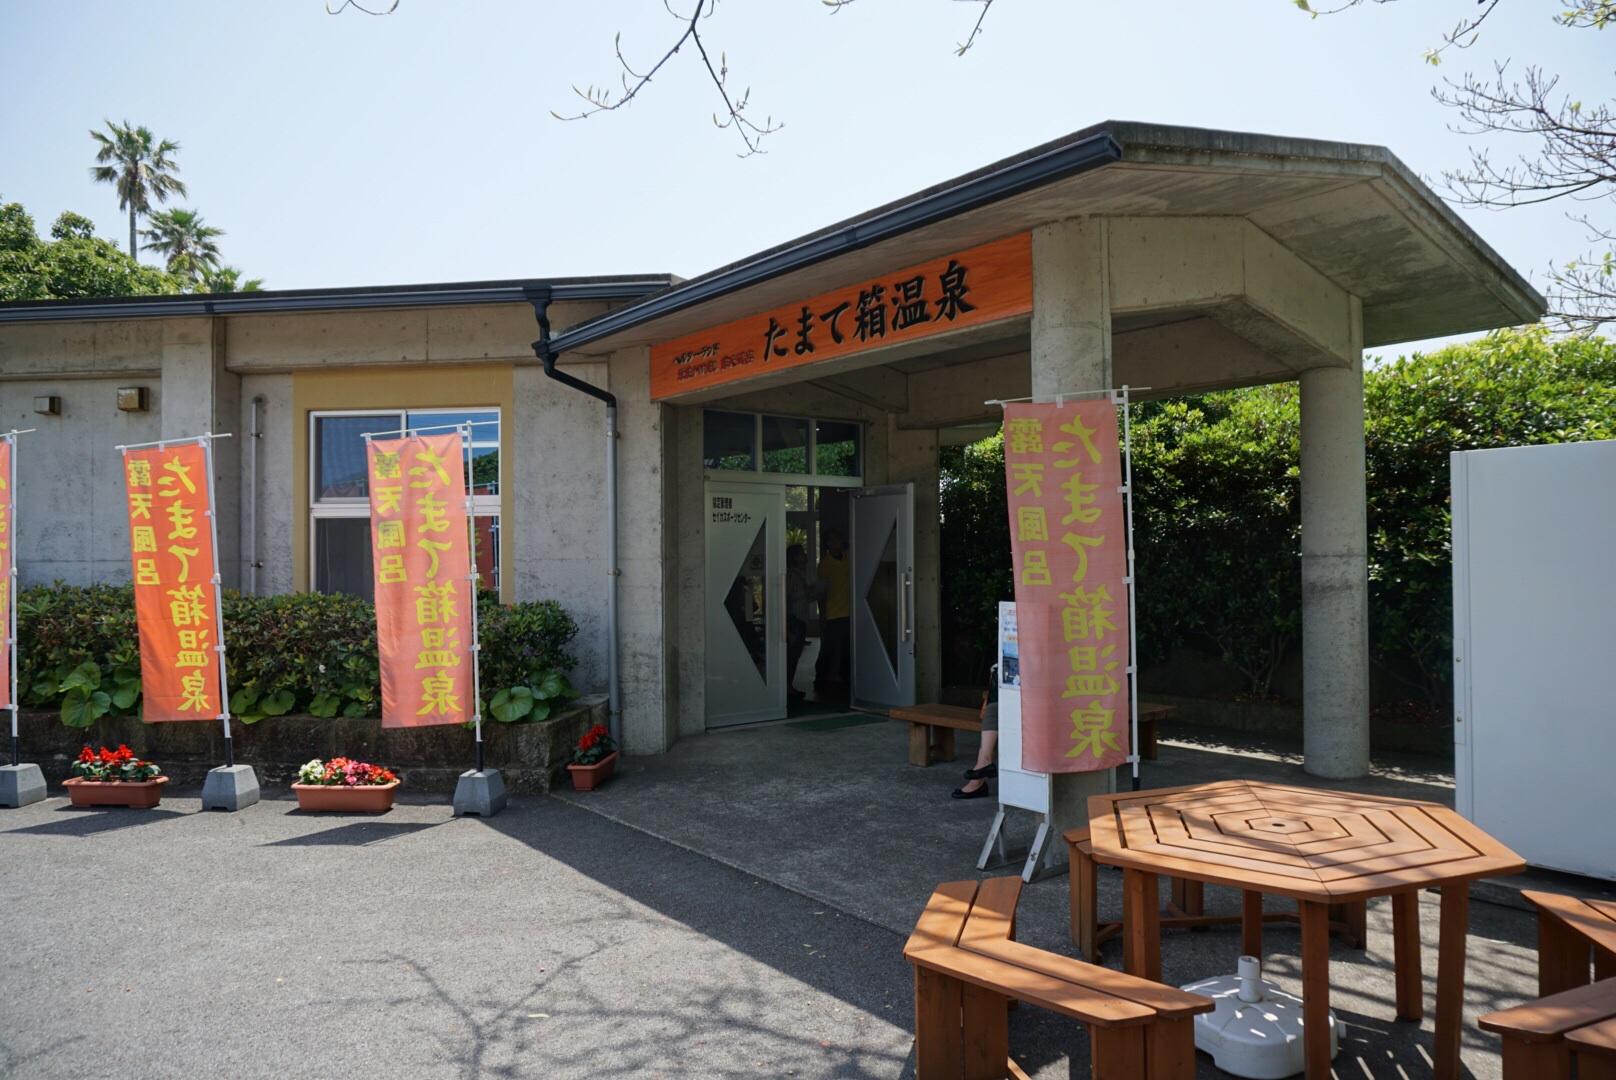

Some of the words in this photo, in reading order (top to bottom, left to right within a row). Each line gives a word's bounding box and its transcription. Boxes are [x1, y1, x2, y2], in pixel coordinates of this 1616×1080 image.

[763, 260, 976, 361] たまて箱温泉
